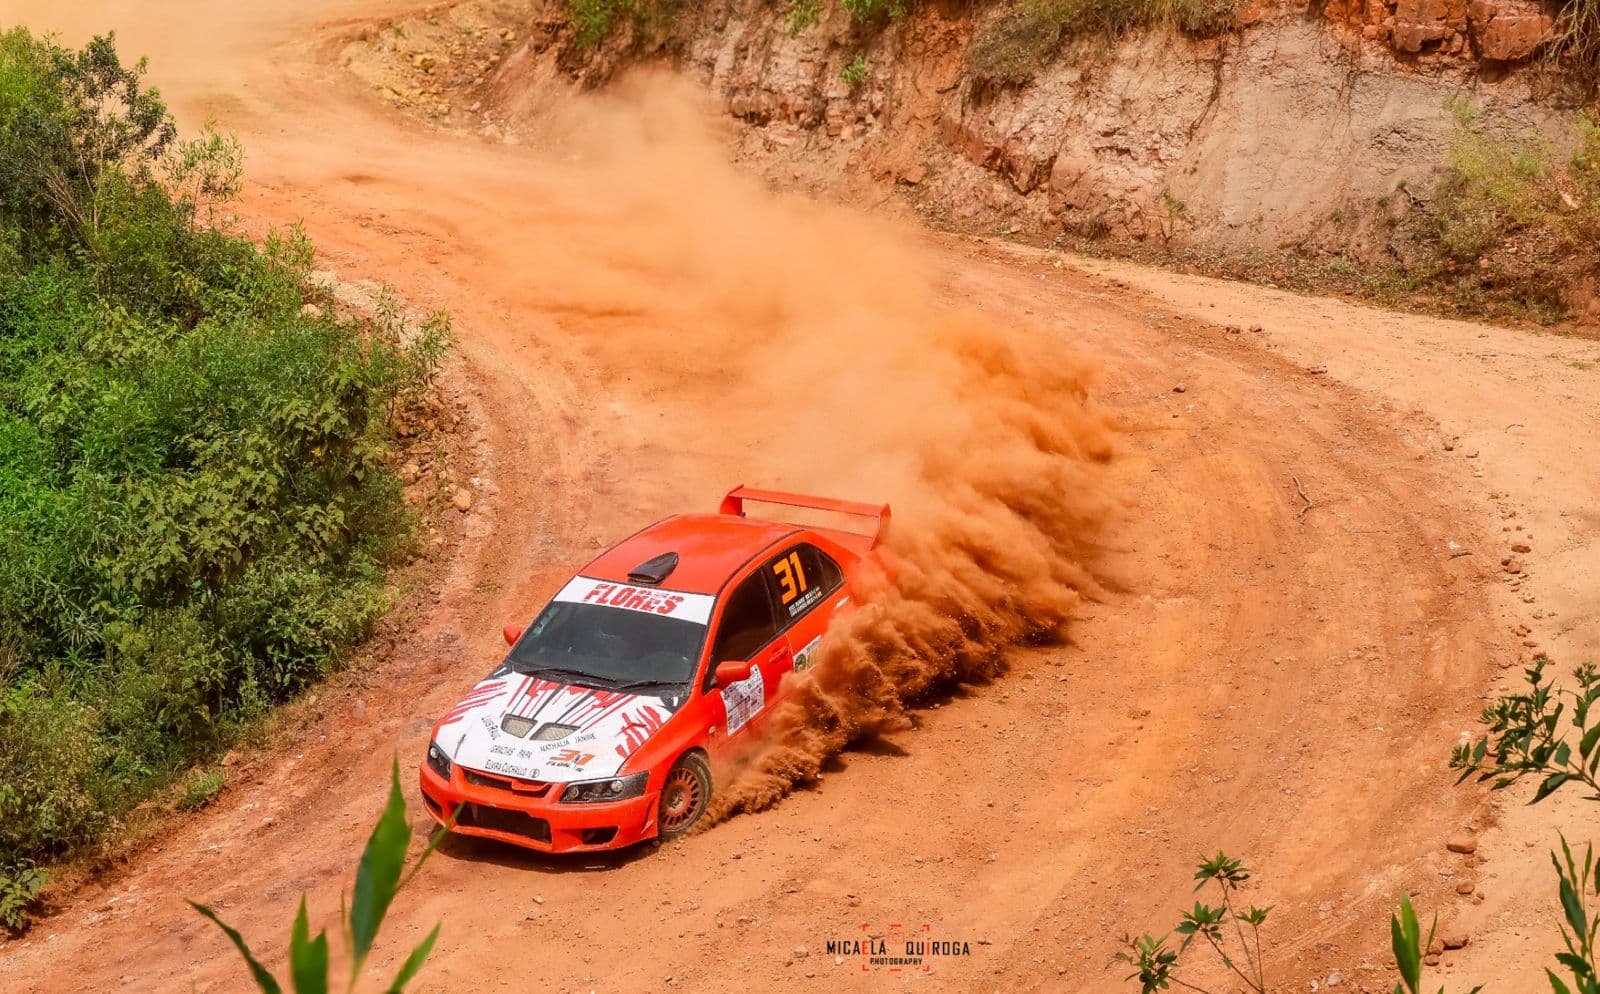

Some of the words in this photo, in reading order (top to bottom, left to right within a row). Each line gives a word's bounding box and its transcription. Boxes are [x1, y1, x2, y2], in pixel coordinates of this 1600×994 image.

[773, 551, 808, 605] 31
[584, 584, 684, 614] FLORES
[490, 744, 514, 756] GRACIAS
[540, 739, 570, 752] NATHALIA
[575, 733, 597, 744] JANINE
[550, 749, 594, 765] 31
